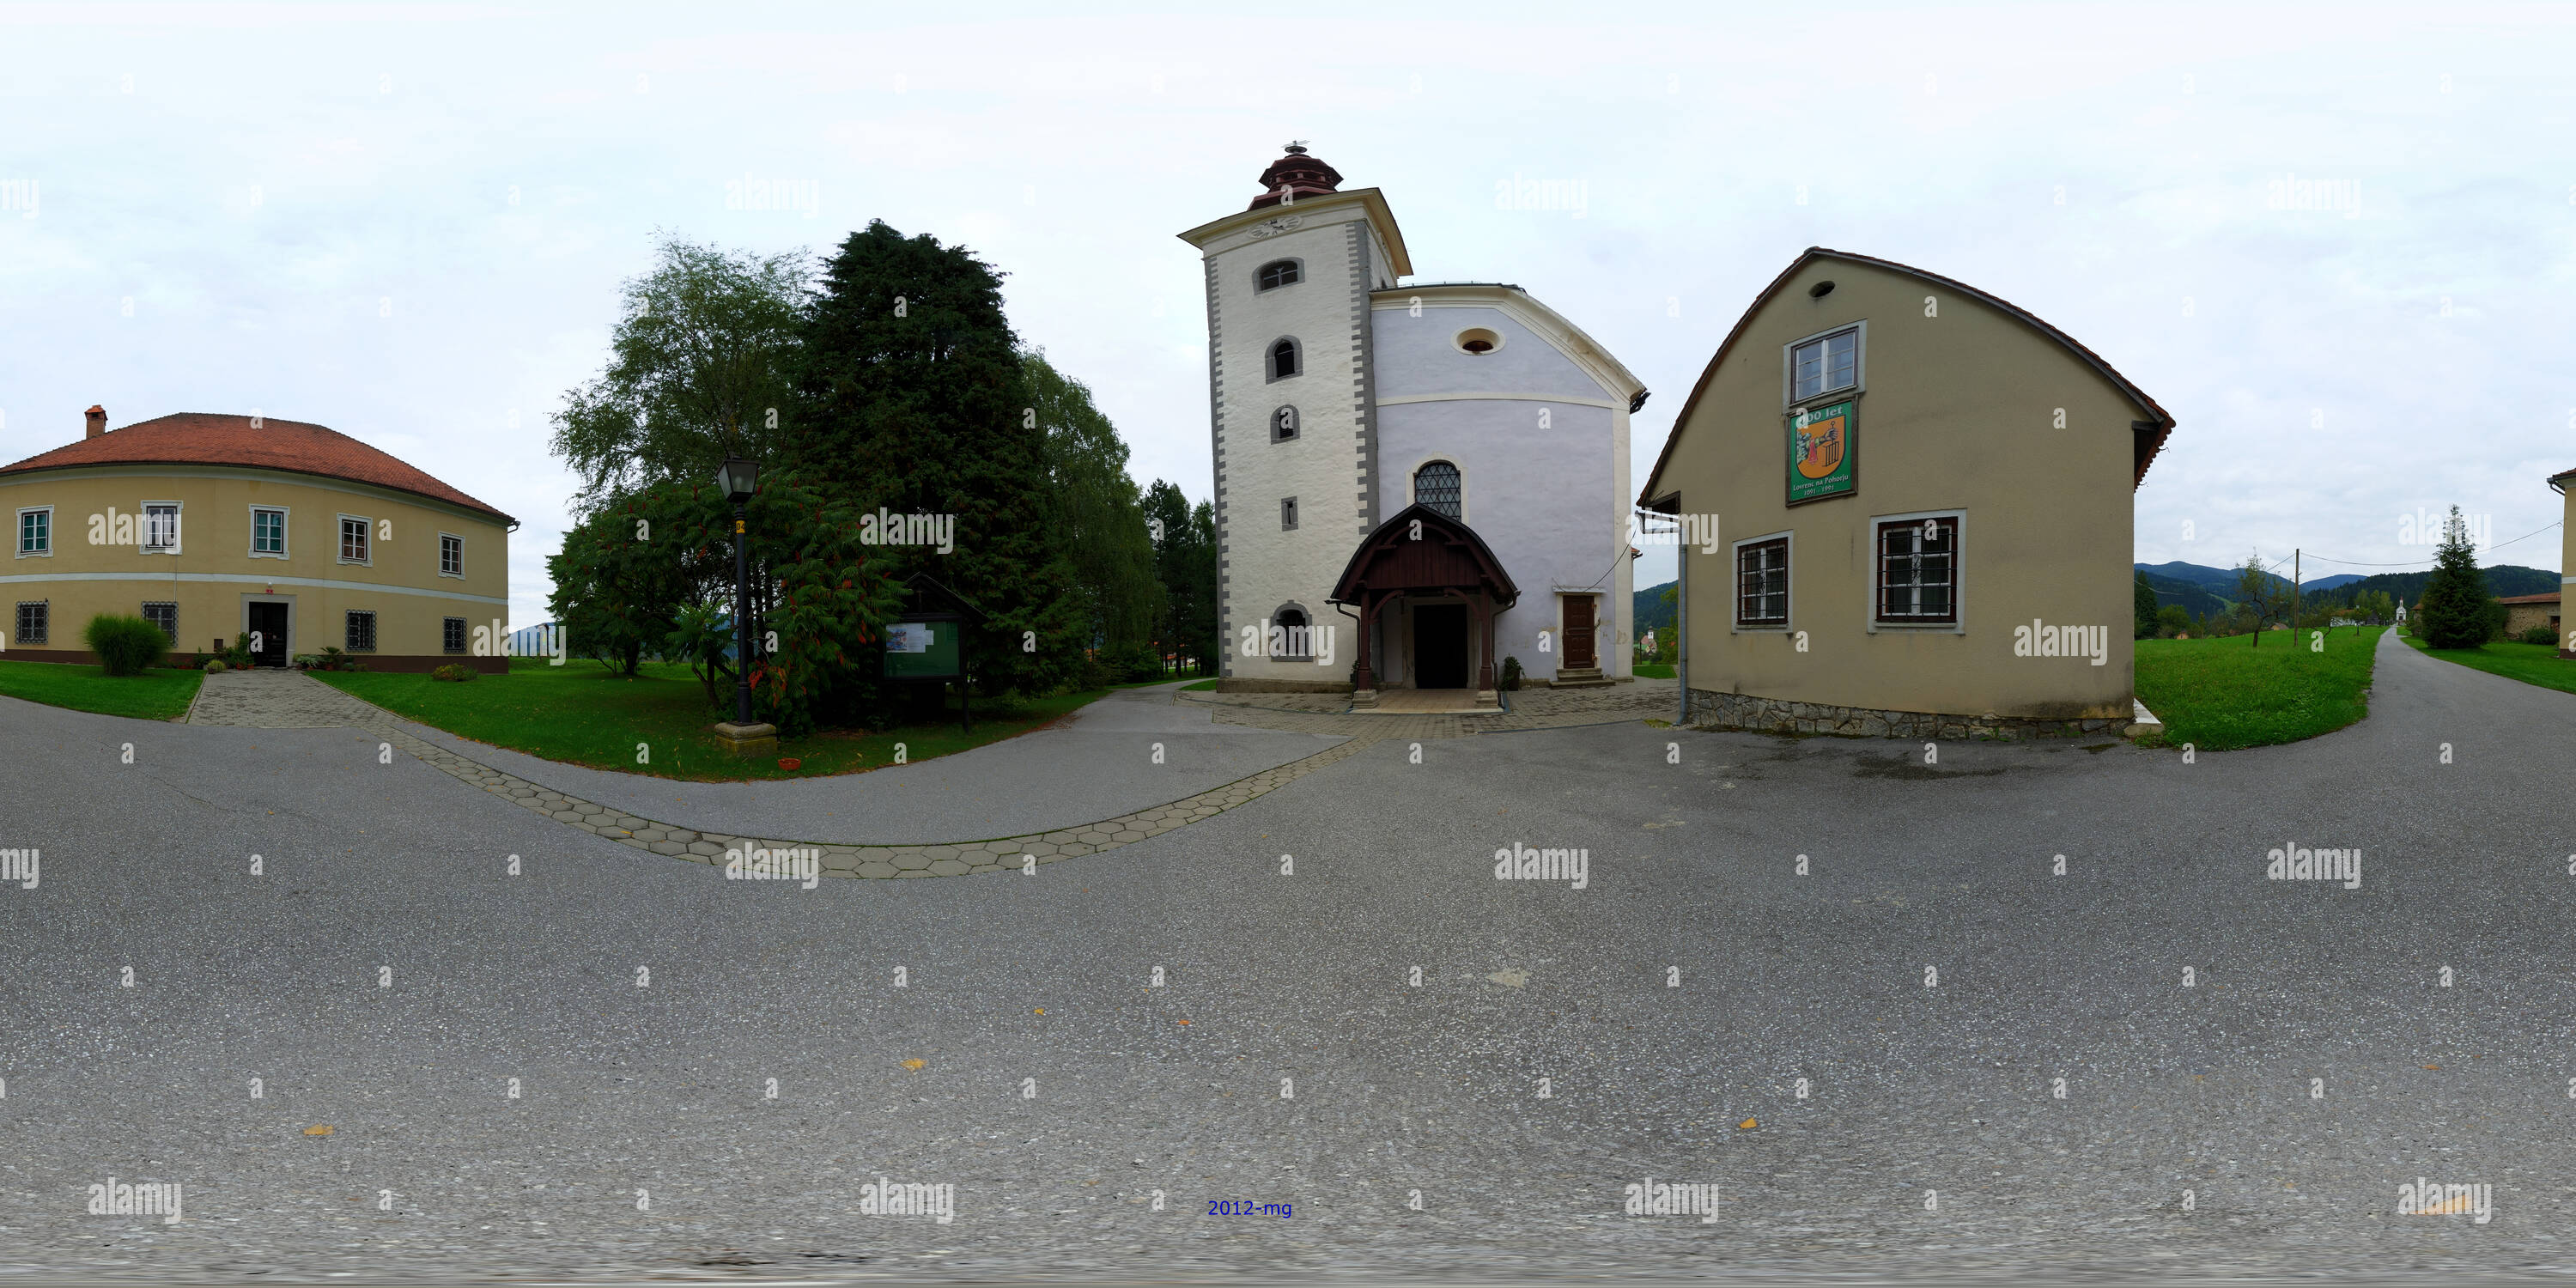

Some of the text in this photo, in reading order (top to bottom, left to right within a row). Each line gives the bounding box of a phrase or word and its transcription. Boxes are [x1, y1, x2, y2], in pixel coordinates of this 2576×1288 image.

[1826, 406, 1843, 417] let
[1793, 483, 1814, 491] Lovrenc
[1825, 474, 1849, 484] Pohorju
